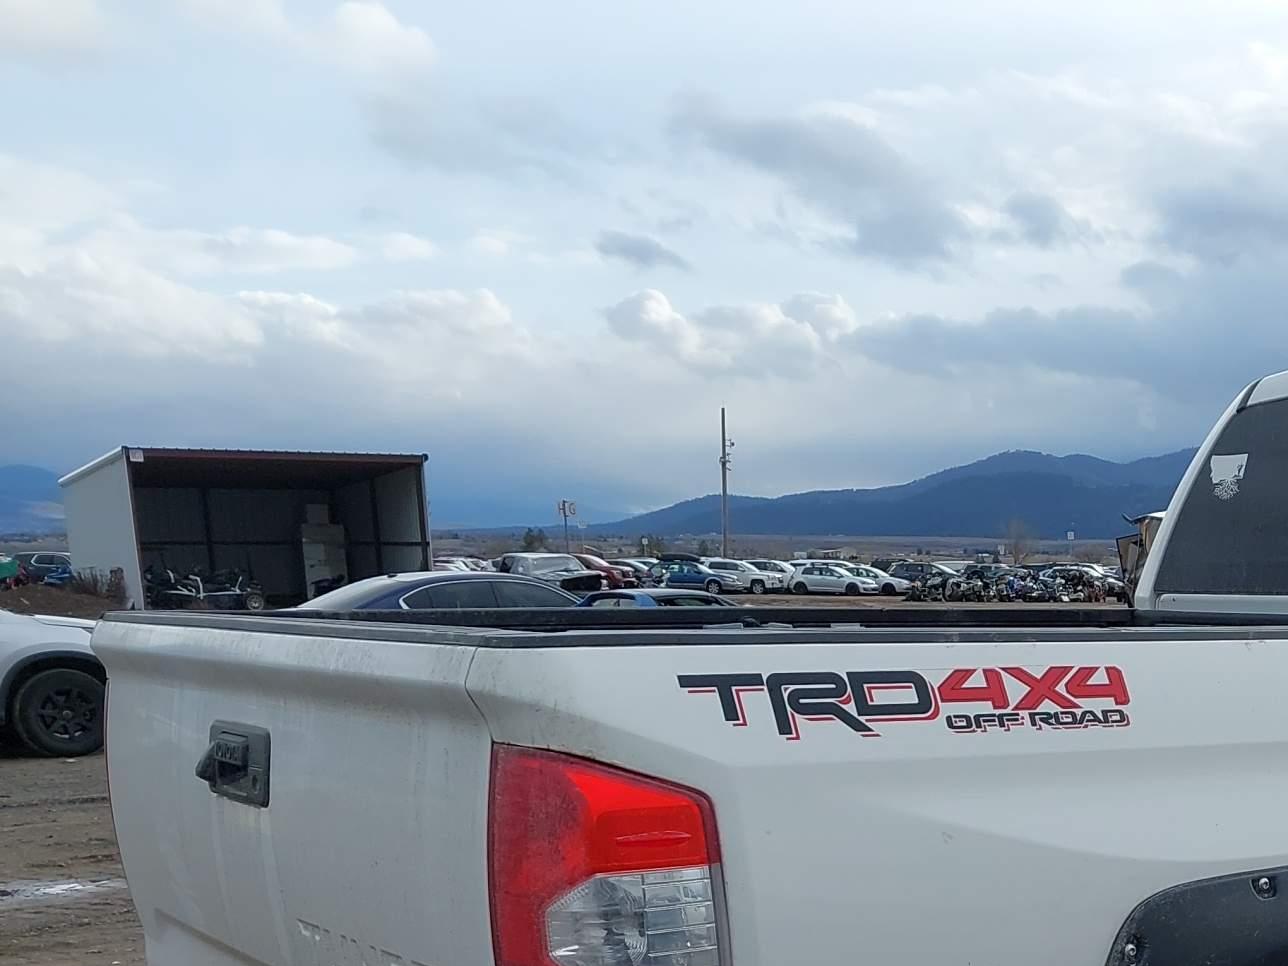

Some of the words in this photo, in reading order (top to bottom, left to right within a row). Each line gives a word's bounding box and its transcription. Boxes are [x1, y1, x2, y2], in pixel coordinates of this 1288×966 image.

[677, 671, 941, 741] TRD
[945, 711, 1026, 734] OFF
[1029, 707, 1131, 729] ROAD
